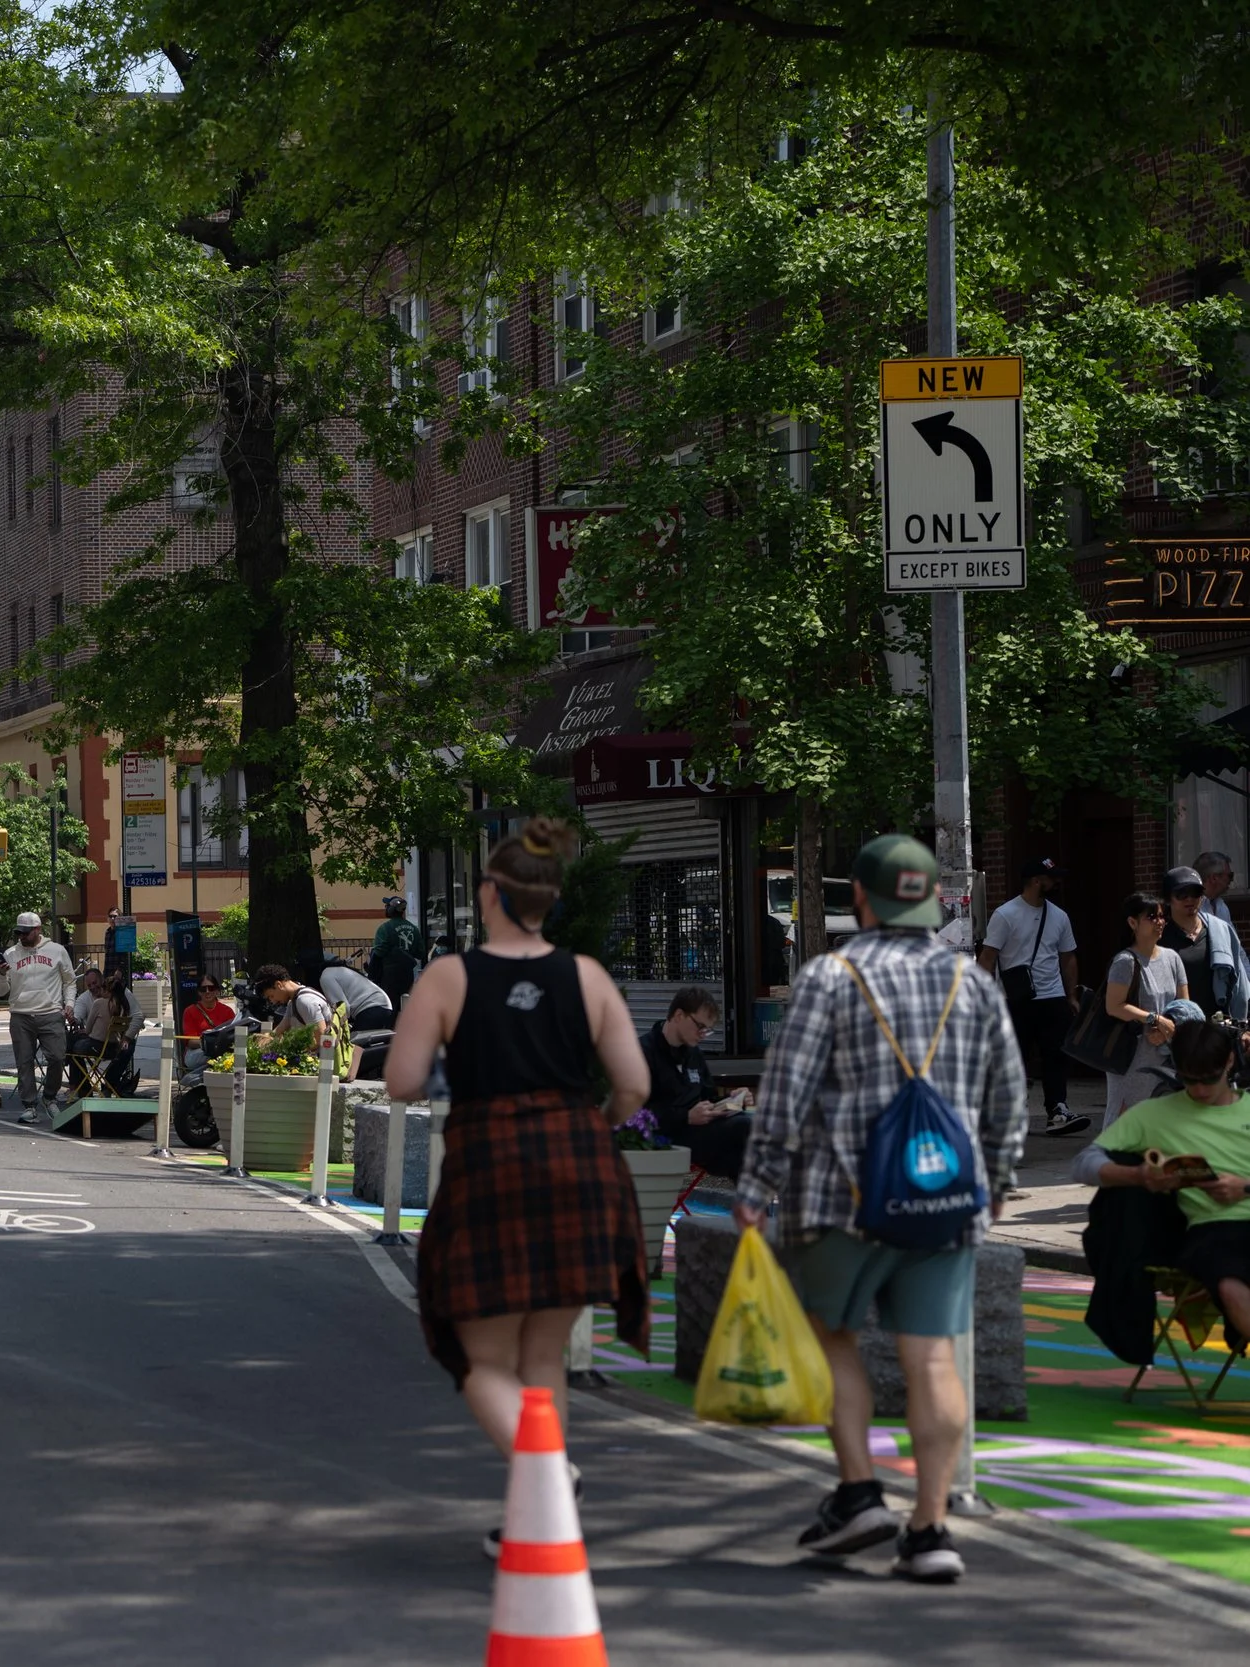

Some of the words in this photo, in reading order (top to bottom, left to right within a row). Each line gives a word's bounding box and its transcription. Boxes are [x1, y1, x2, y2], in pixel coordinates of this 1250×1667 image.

[918, 366, 984, 392] NEW
[904, 512, 1002, 544] ONLY
[900, 562, 958, 579] EXCEPT
[966, 561, 1010, 577] BIKES
[1157, 571, 1244, 608] PIZZ
[562, 678, 614, 710] VUKEL
[560, 706, 615, 731] GROUP
[127, 816, 134, 827] 2
[16, 956, 31, 970] NEW
[33, 955, 53, 968] YORK
